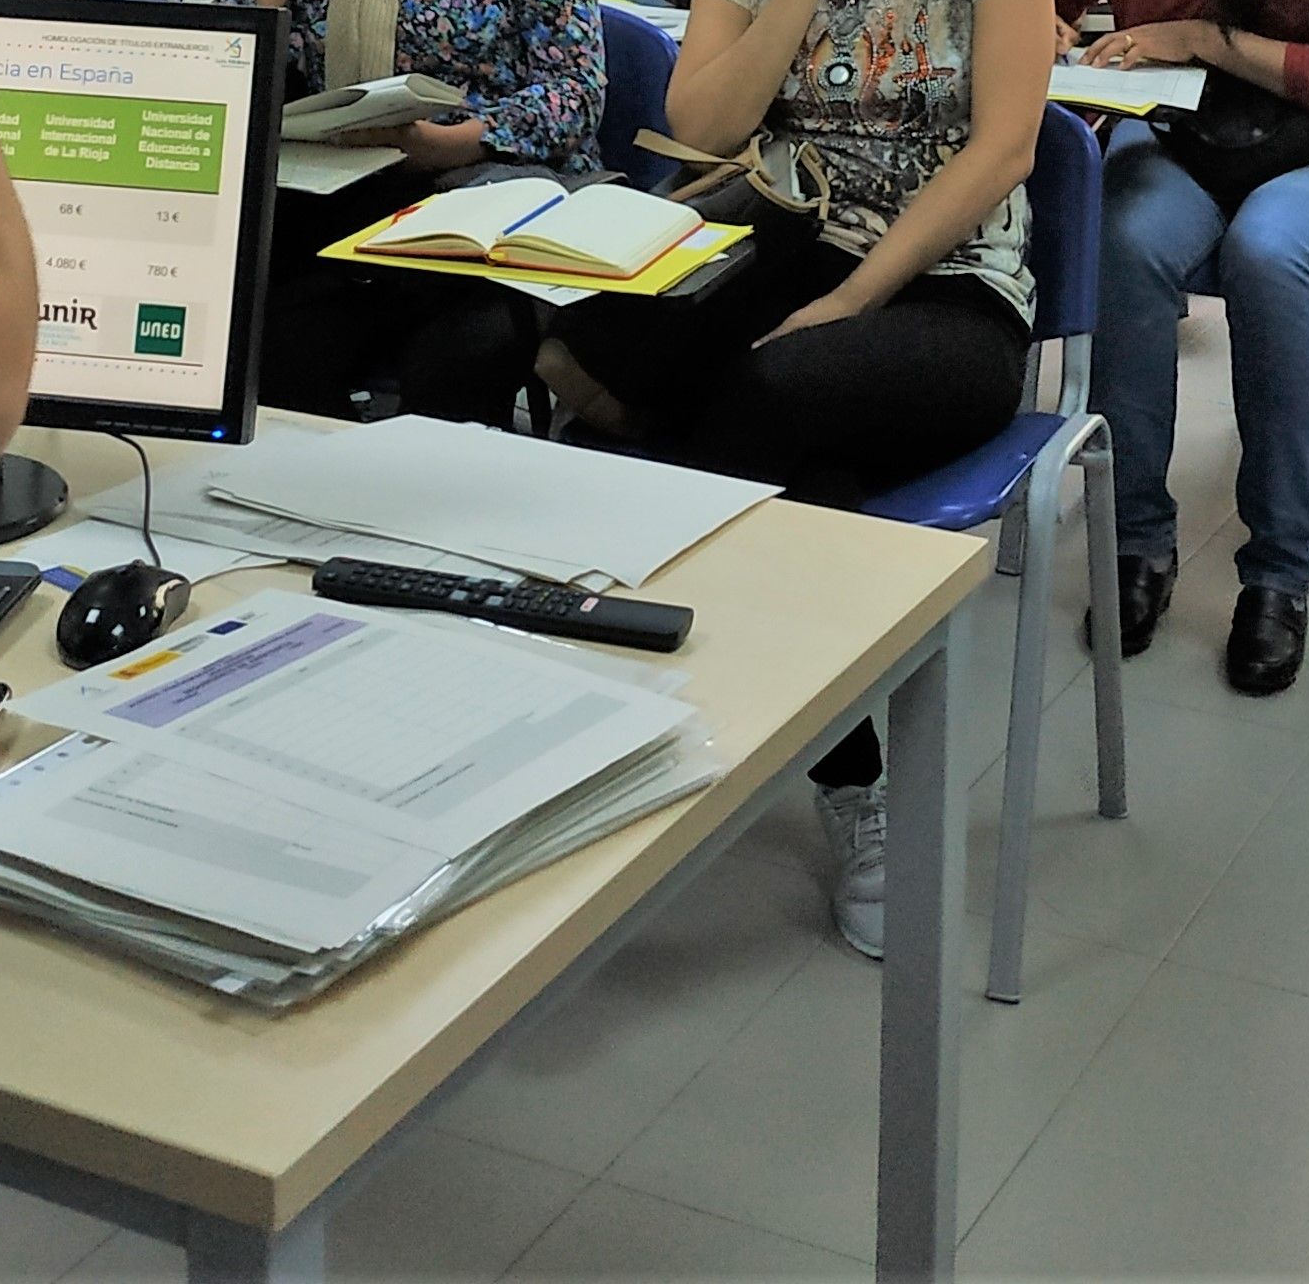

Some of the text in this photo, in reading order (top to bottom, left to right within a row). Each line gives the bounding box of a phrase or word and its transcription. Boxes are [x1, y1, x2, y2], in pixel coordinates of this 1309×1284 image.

[27, 64, 52, 79] en
[60, 63, 134, 85] España
[46, 114, 115, 130] Universidad
[142, 110, 213, 126] Universidad
[40, 129, 117, 145] Internacional
[141, 125, 211, 141] Nacional de
[44, 145, 110, 162] de La Rioja
[138, 140, 211, 156] Educación a
[145, 156, 200, 172] Distancia
[59, 203, 83, 215] 68 €
[156, 211, 180, 222] 13 €
[46, 257, 88, 270] 4.080 €
[147, 264, 178, 277] 780 €
